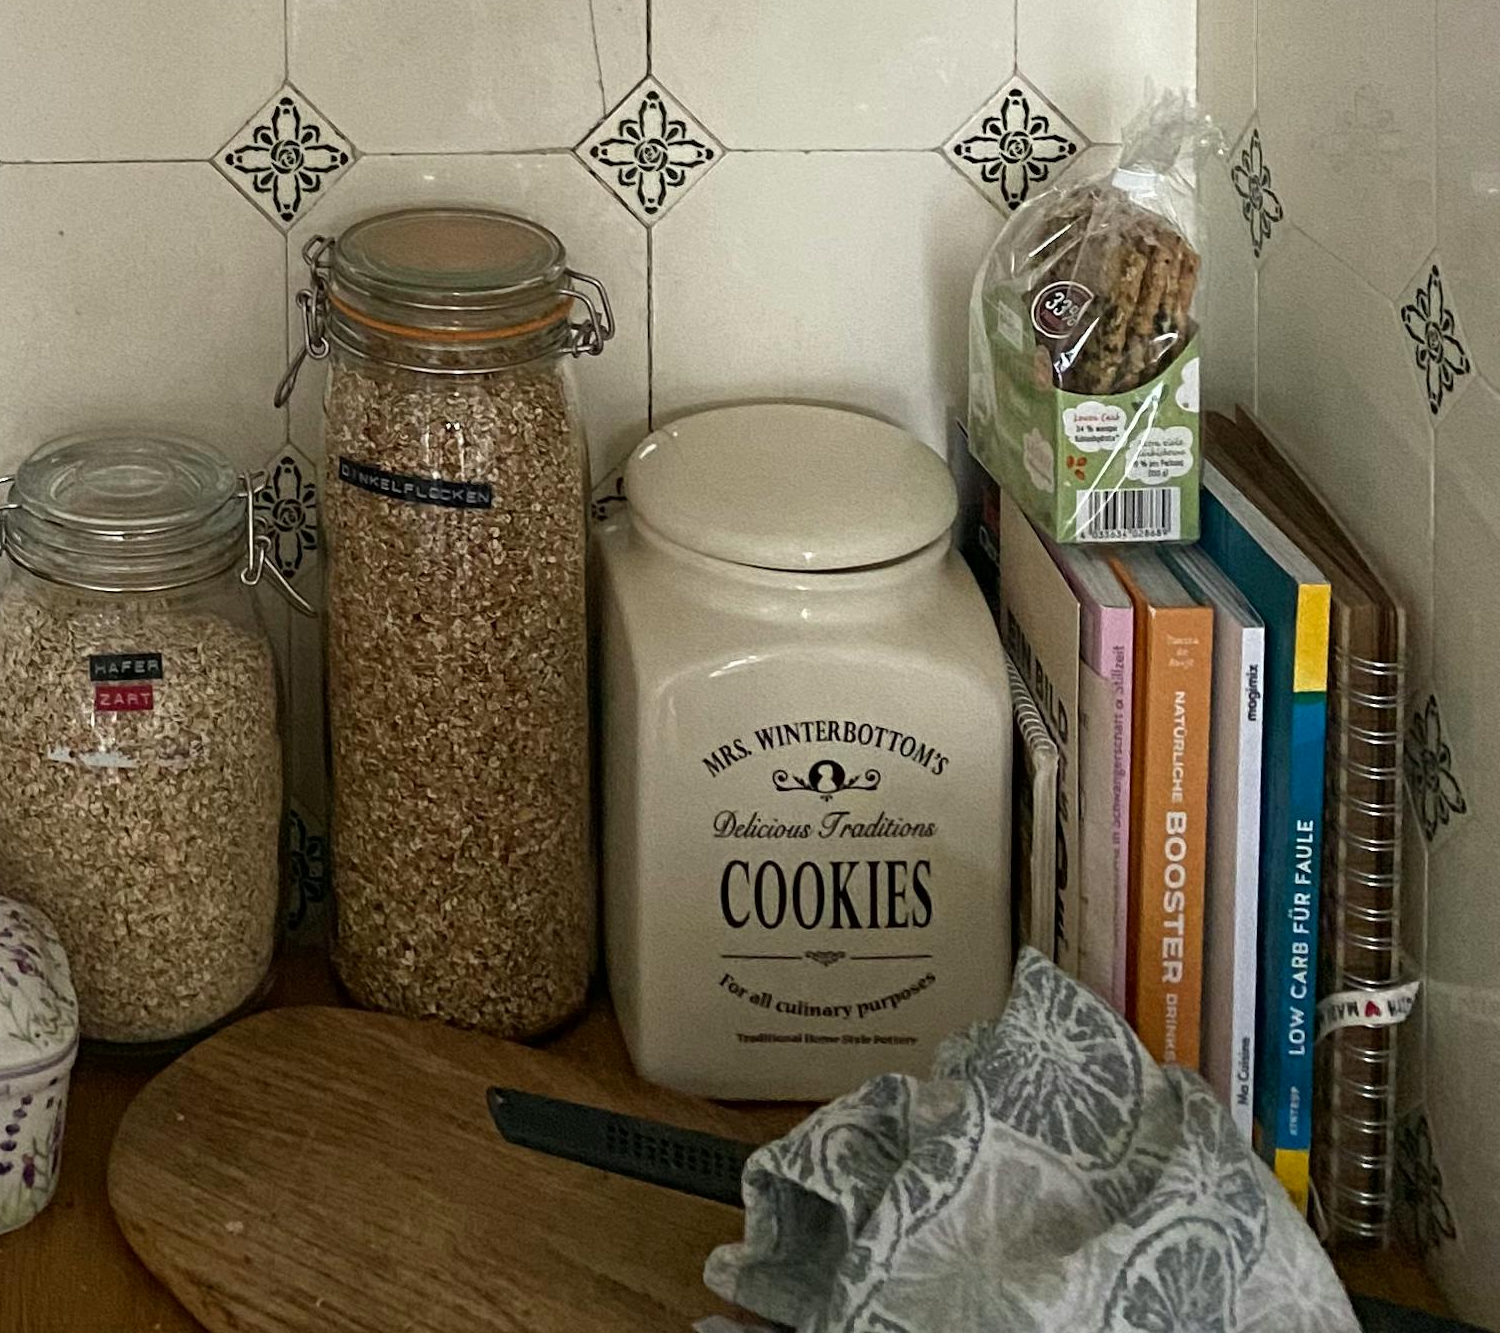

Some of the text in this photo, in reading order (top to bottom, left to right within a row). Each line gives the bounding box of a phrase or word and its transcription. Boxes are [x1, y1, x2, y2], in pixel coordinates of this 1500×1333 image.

[341, 463, 491, 504] DINKELFLOCKEN
[94, 658, 160, 675] HAFER
[1246, 663, 1261, 721] magimix
[99, 692, 151, 707] ZART
[703, 720, 949, 778] MRS. WINTERBOTTOM'S
[1172, 690, 1187, 804] NATÜRLICHE
[712, 809, 938, 838] Delicious Traditions
[720, 859, 933, 930] COOKIES
[1162, 811, 1187, 983] BOOSTER
[1288, 819, 1314, 1056] LOW CARB FÜR FAULE
[718, 972, 937, 1020] For all culinary purposes
